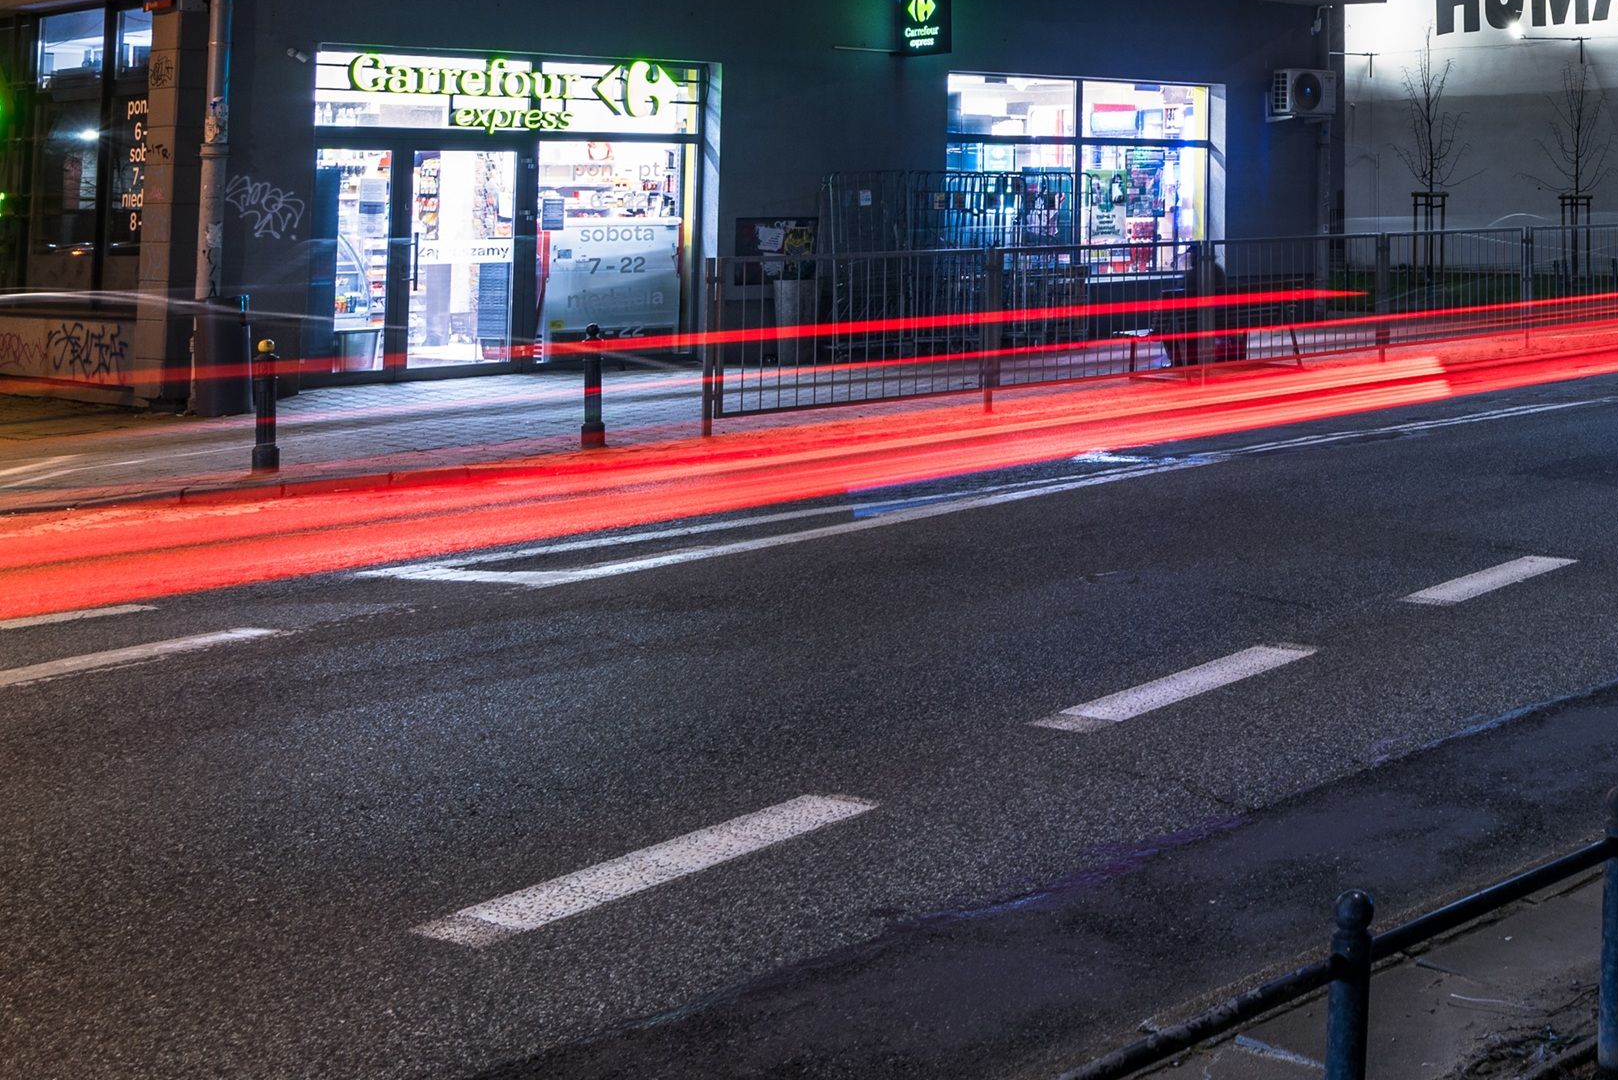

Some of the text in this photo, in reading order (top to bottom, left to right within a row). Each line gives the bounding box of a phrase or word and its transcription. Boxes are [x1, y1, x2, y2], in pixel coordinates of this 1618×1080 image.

[905, 25, 939, 38] Carrefour
[351, 53, 582, 100] Carrefour
[128, 99, 149, 120] pon.
[455, 106, 575, 134] express
[134, 122, 141, 140] 6
[132, 167, 139, 185] 7
[572, 163, 618, 181] pon.
[129, 212, 137, 231] 8
[580, 225, 655, 243] sobota
[589, 257, 601, 275] 7
[620, 256, 646, 274] 22
[619, 320, 644, 338] 22
